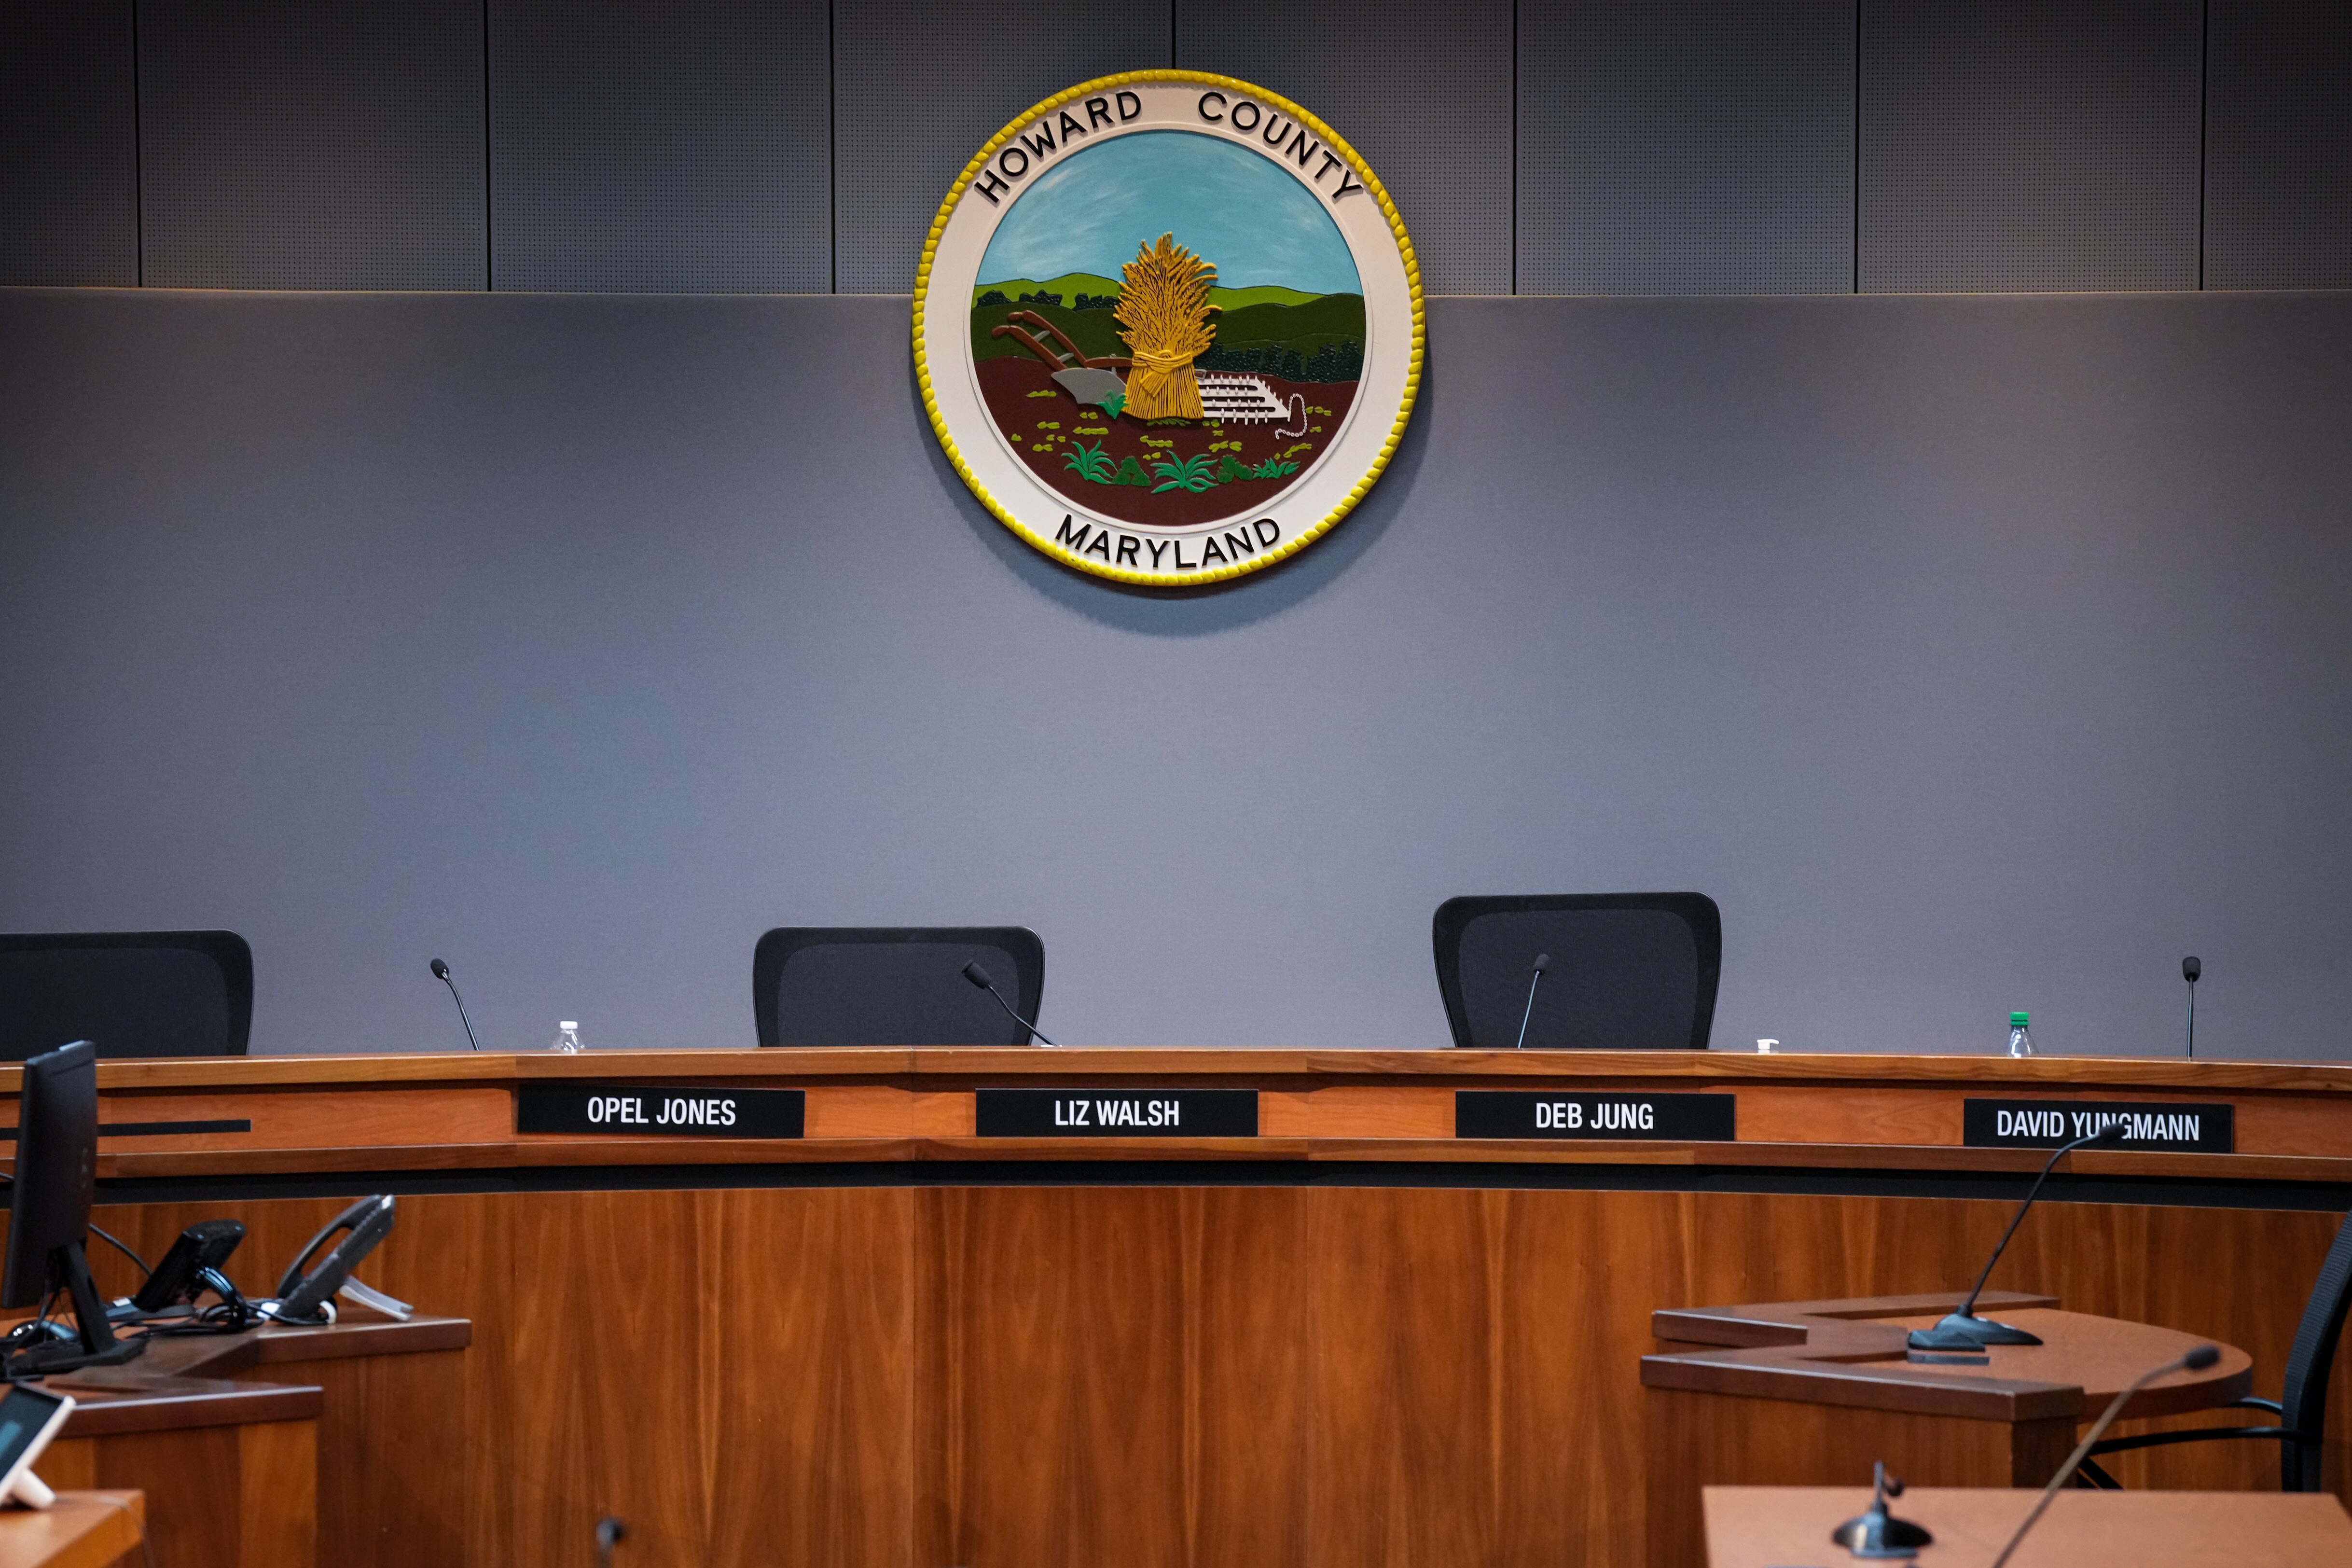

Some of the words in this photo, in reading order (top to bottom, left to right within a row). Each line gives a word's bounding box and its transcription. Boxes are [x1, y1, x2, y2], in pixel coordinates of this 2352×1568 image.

[974, 91, 1142, 204] HOWARD
[1198, 91, 1364, 200] COUNTY
[1055, 513, 1280, 569] MARYLAND
[588, 1096, 649, 1124] OPEL
[656, 1098, 736, 1125] JONES
[1055, 1100, 1090, 1126] LIZ
[1096, 1100, 1180, 1126] WALSH
[1536, 1102, 1583, 1128] DEB
[1590, 1103, 1654, 1130] JUNG
[1997, 1110, 2064, 1138] DAVID
